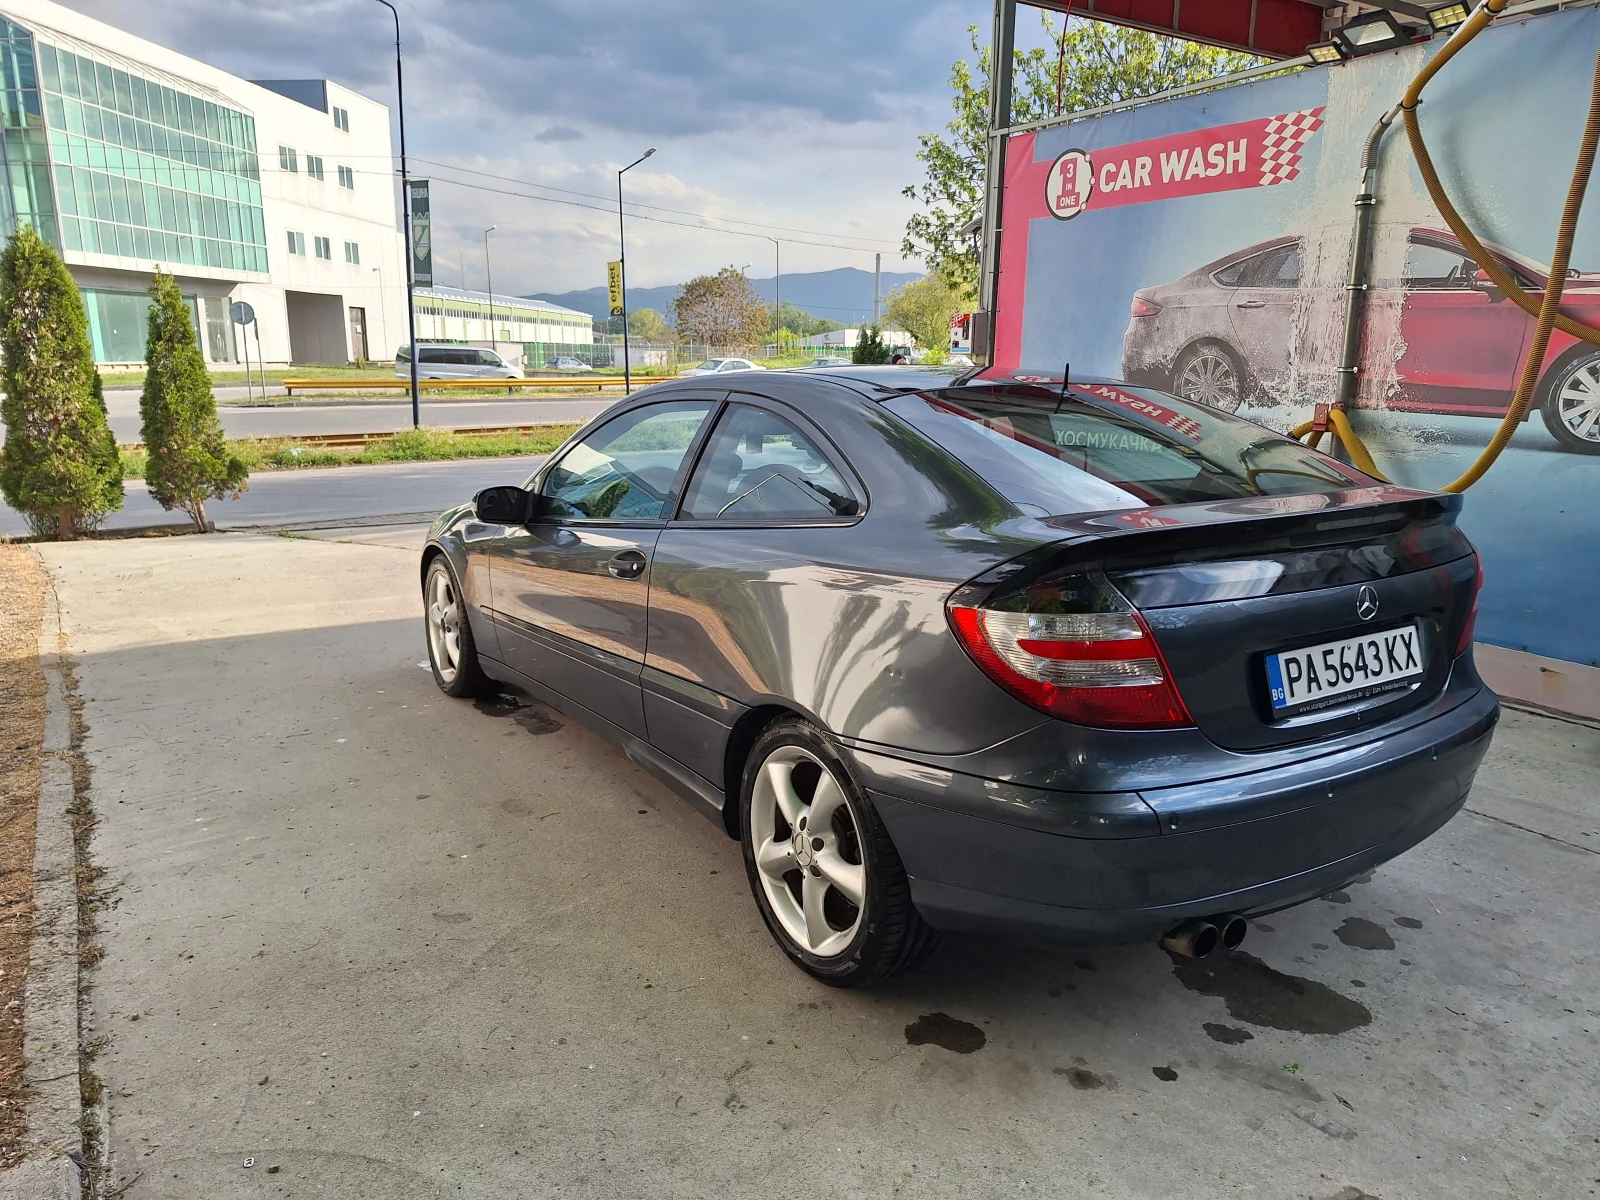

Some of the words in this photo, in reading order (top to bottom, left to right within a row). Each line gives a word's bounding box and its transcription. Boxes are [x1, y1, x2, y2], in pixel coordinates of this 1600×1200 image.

[1066, 163, 1074, 179] 3
[1100, 156, 1152, 193] CAR
[1160, 138, 1248, 184] WASH
[1065, 182, 1073, 191] IN
[1060, 195, 1076, 207] ONE
[1272, 688, 1285, 700] BG
